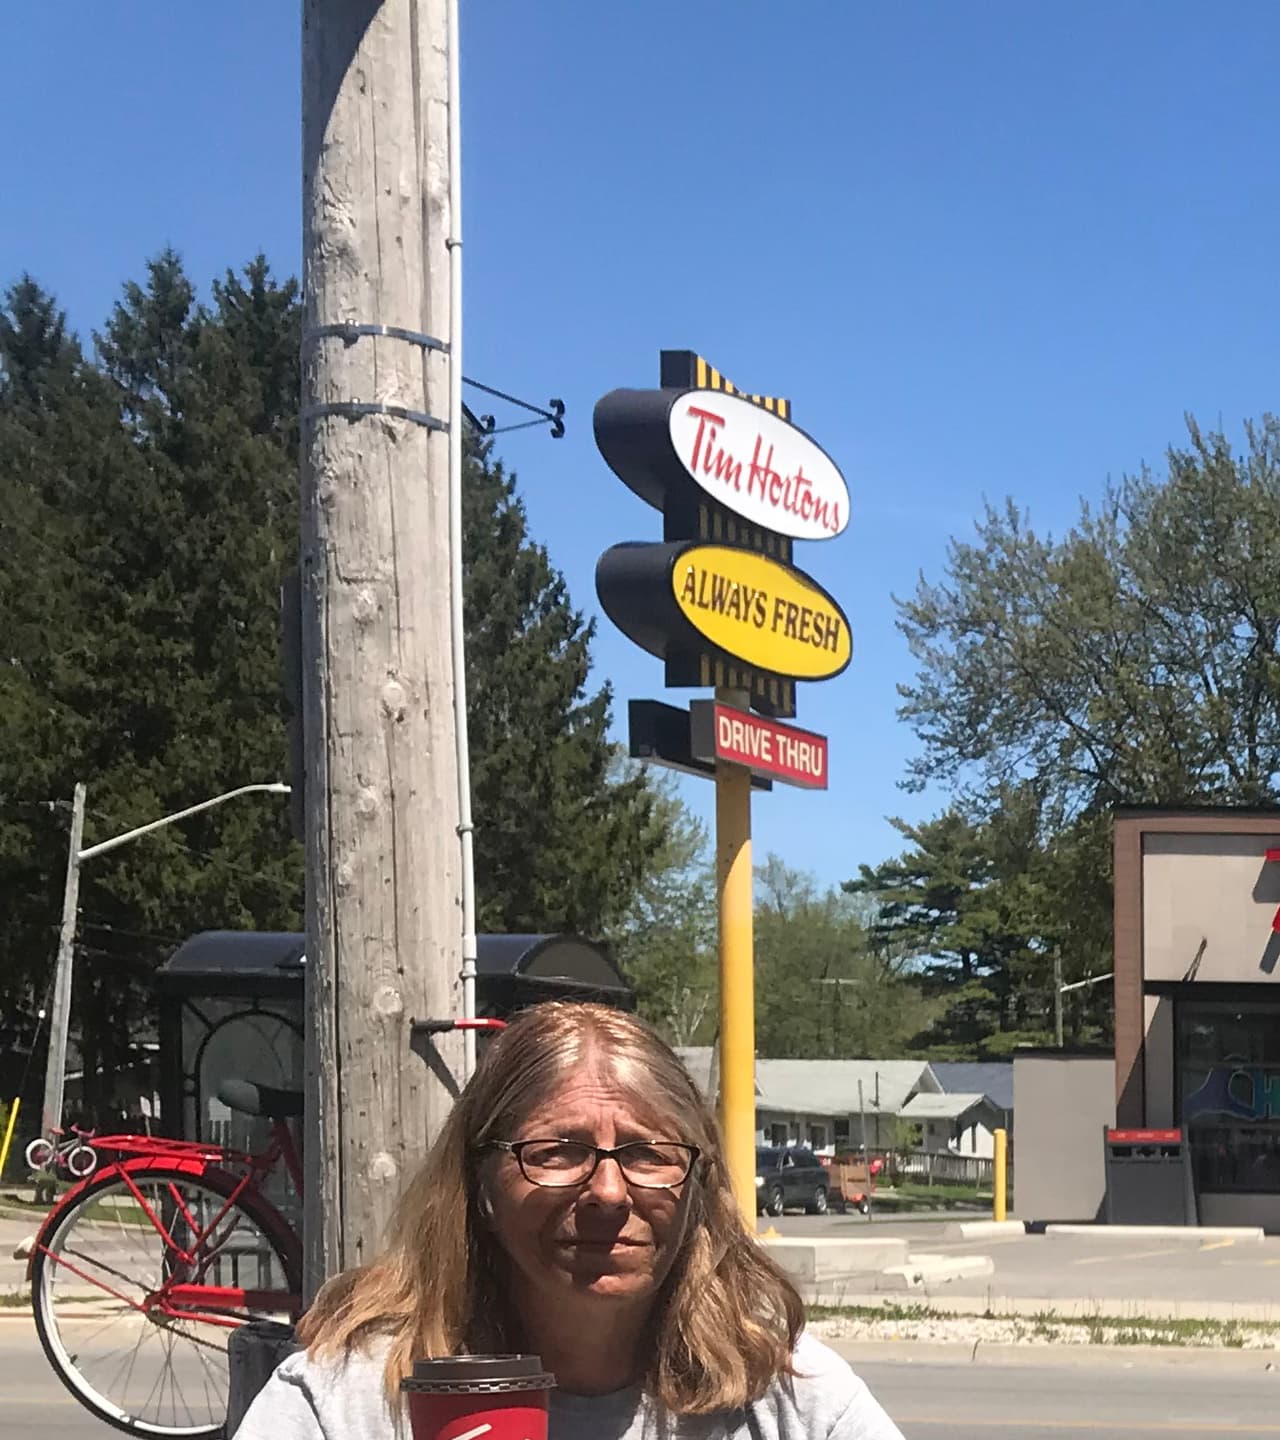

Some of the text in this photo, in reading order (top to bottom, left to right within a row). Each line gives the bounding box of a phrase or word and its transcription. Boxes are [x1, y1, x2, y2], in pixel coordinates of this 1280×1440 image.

[688, 406, 839, 534] Tim Hortons
[681, 566, 840, 654] ALWAYS FRESH
[719, 716, 823, 777] DRIVE THRU
